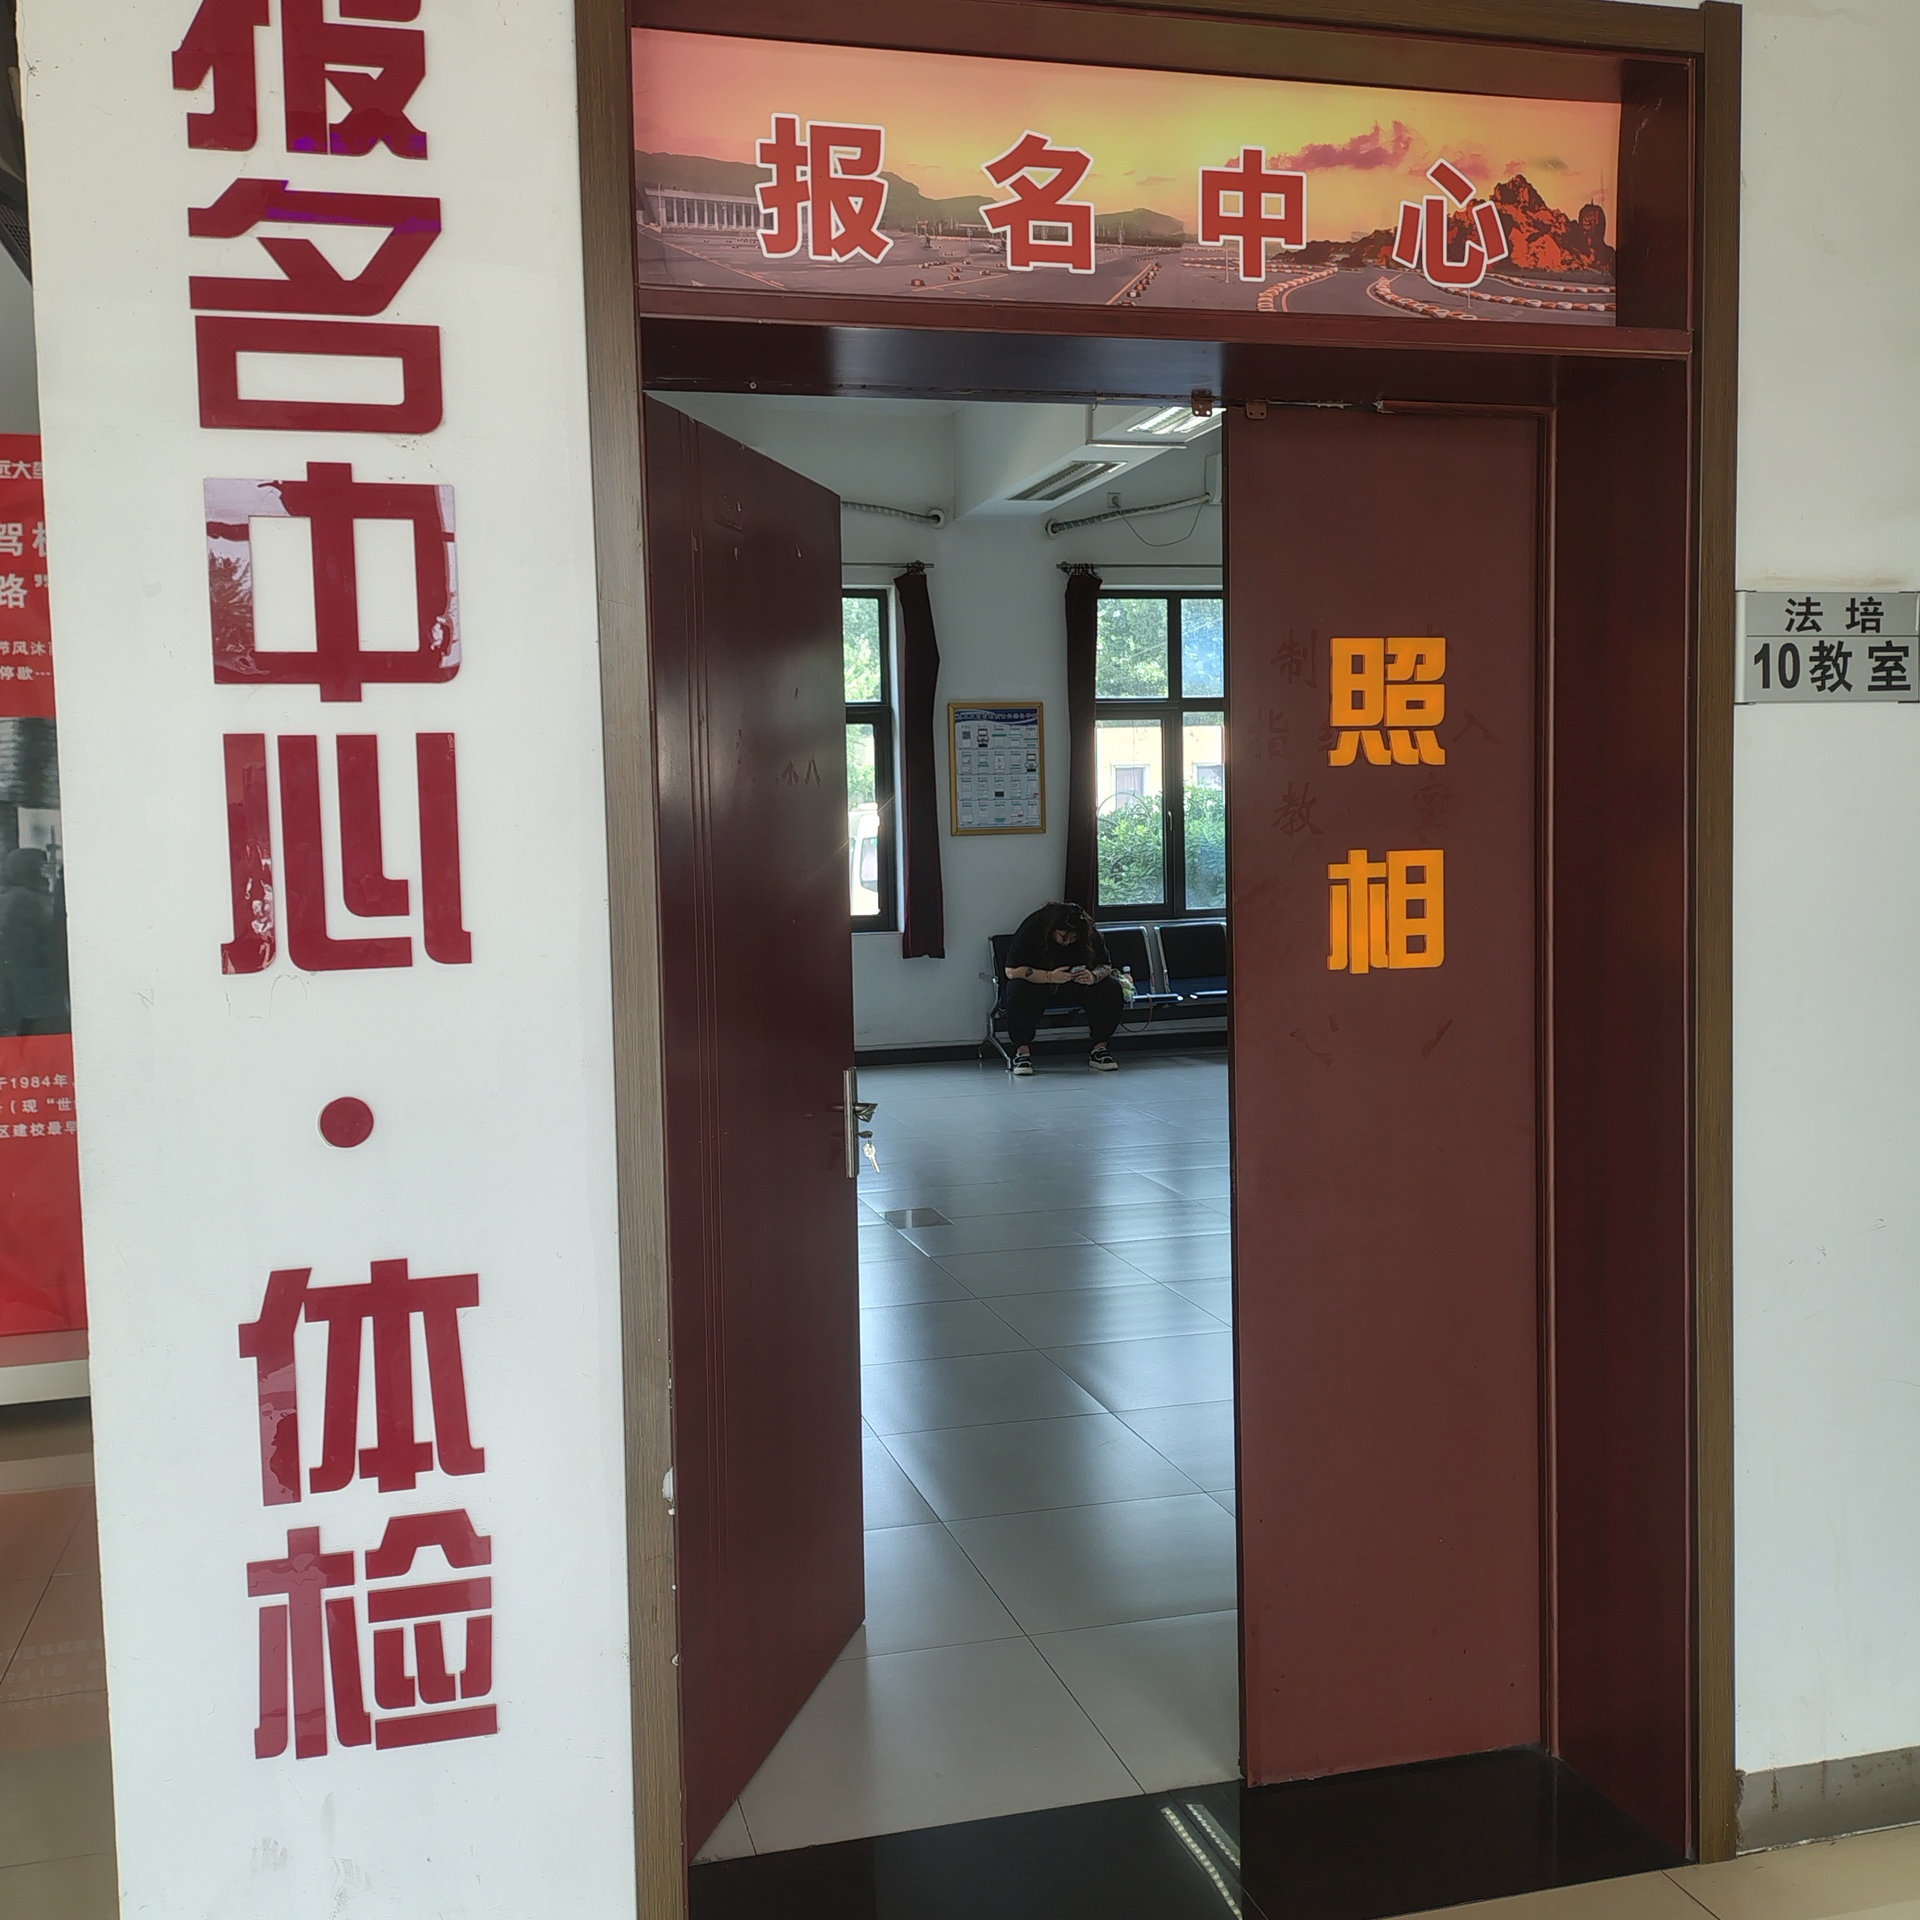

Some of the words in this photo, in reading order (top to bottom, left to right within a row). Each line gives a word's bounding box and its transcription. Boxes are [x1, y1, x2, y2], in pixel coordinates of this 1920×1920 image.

[755, 111, 1509, 289] 报名中心
[1754, 640, 1911, 693] 10教室
[1785, 596, 1884, 633] 法培
[1327, 637, 1446, 974] 照相
